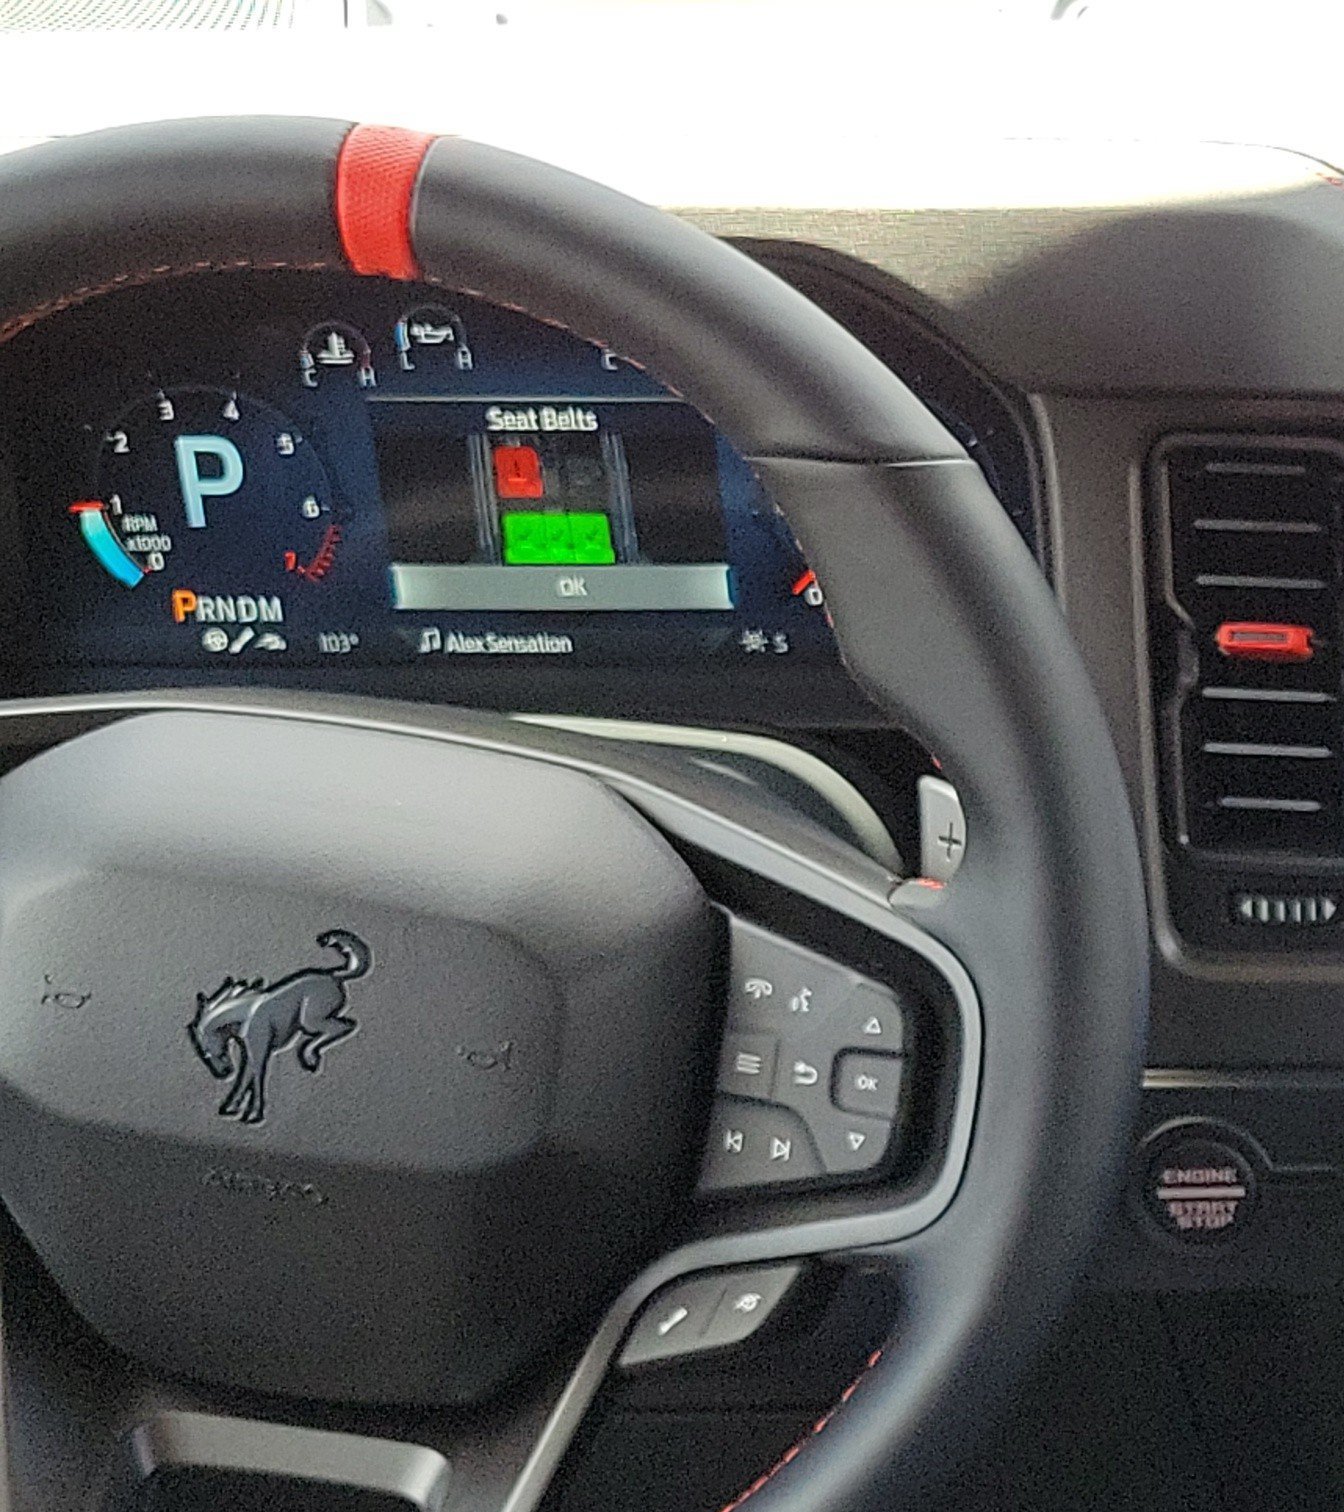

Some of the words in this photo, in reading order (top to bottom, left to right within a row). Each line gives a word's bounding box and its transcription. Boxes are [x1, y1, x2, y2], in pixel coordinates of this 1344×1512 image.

[157, 404, 175, 421] 3
[222, 402, 240, 421] 4
[485, 405, 539, 431] Seat
[540, 405, 599, 431] Belts
[113, 430, 131, 454] 2
[276, 432, 295, 455] 5
[173, 433, 244, 528] P
[109, 494, 123, 516] 1
[302, 495, 321, 518] 6
[121, 514, 158, 533] RPM
[147, 552, 165, 572] 0
[557, 575, 588, 598] OK
[445, 631, 484, 654] Alex
[485, 631, 574, 654] Sensation
[856, 1075, 878, 1091] OK
